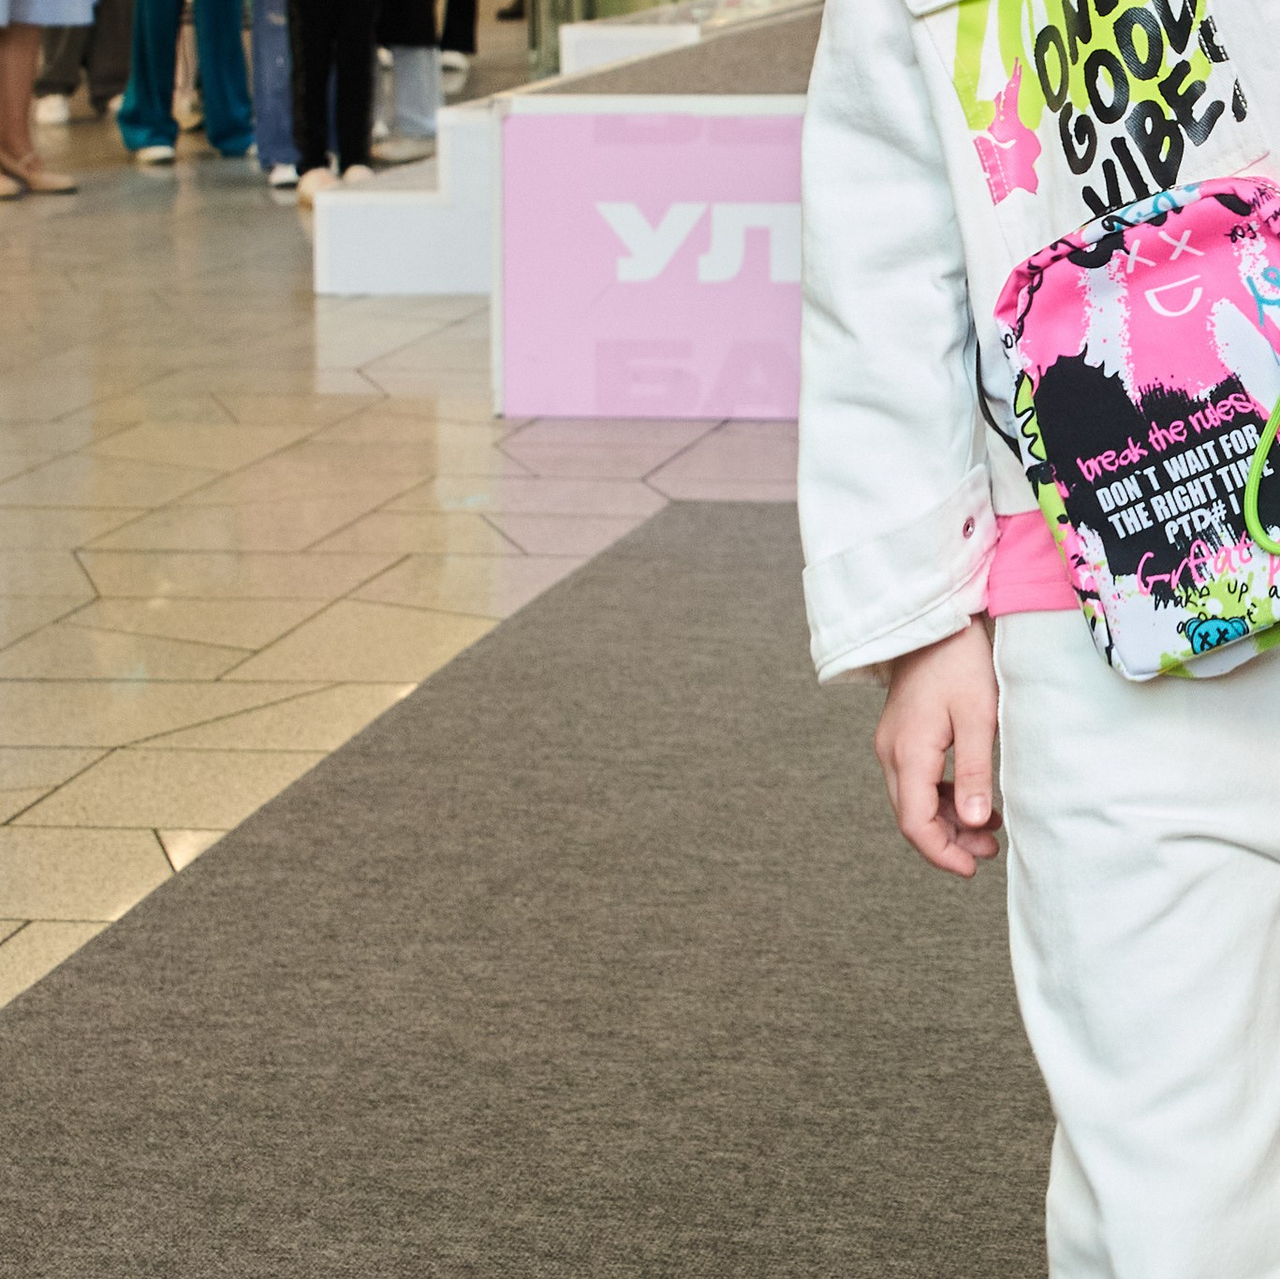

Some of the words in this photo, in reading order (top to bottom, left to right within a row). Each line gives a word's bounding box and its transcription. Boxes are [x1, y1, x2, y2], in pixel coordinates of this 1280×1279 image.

[1075, 436, 1149, 483] break
[1148, 421, 1188, 453] the
[1188, 392, 1256, 434] rules
[1162, 439, 1220, 483] WAIT
[1218, 424, 1261, 460] FOR
[1107, 501, 1154, 540] THE
[1149, 473, 1218, 523] RIGHT
[1136, 530, 1254, 597] Great
[1226, 579, 1249, 603] up
